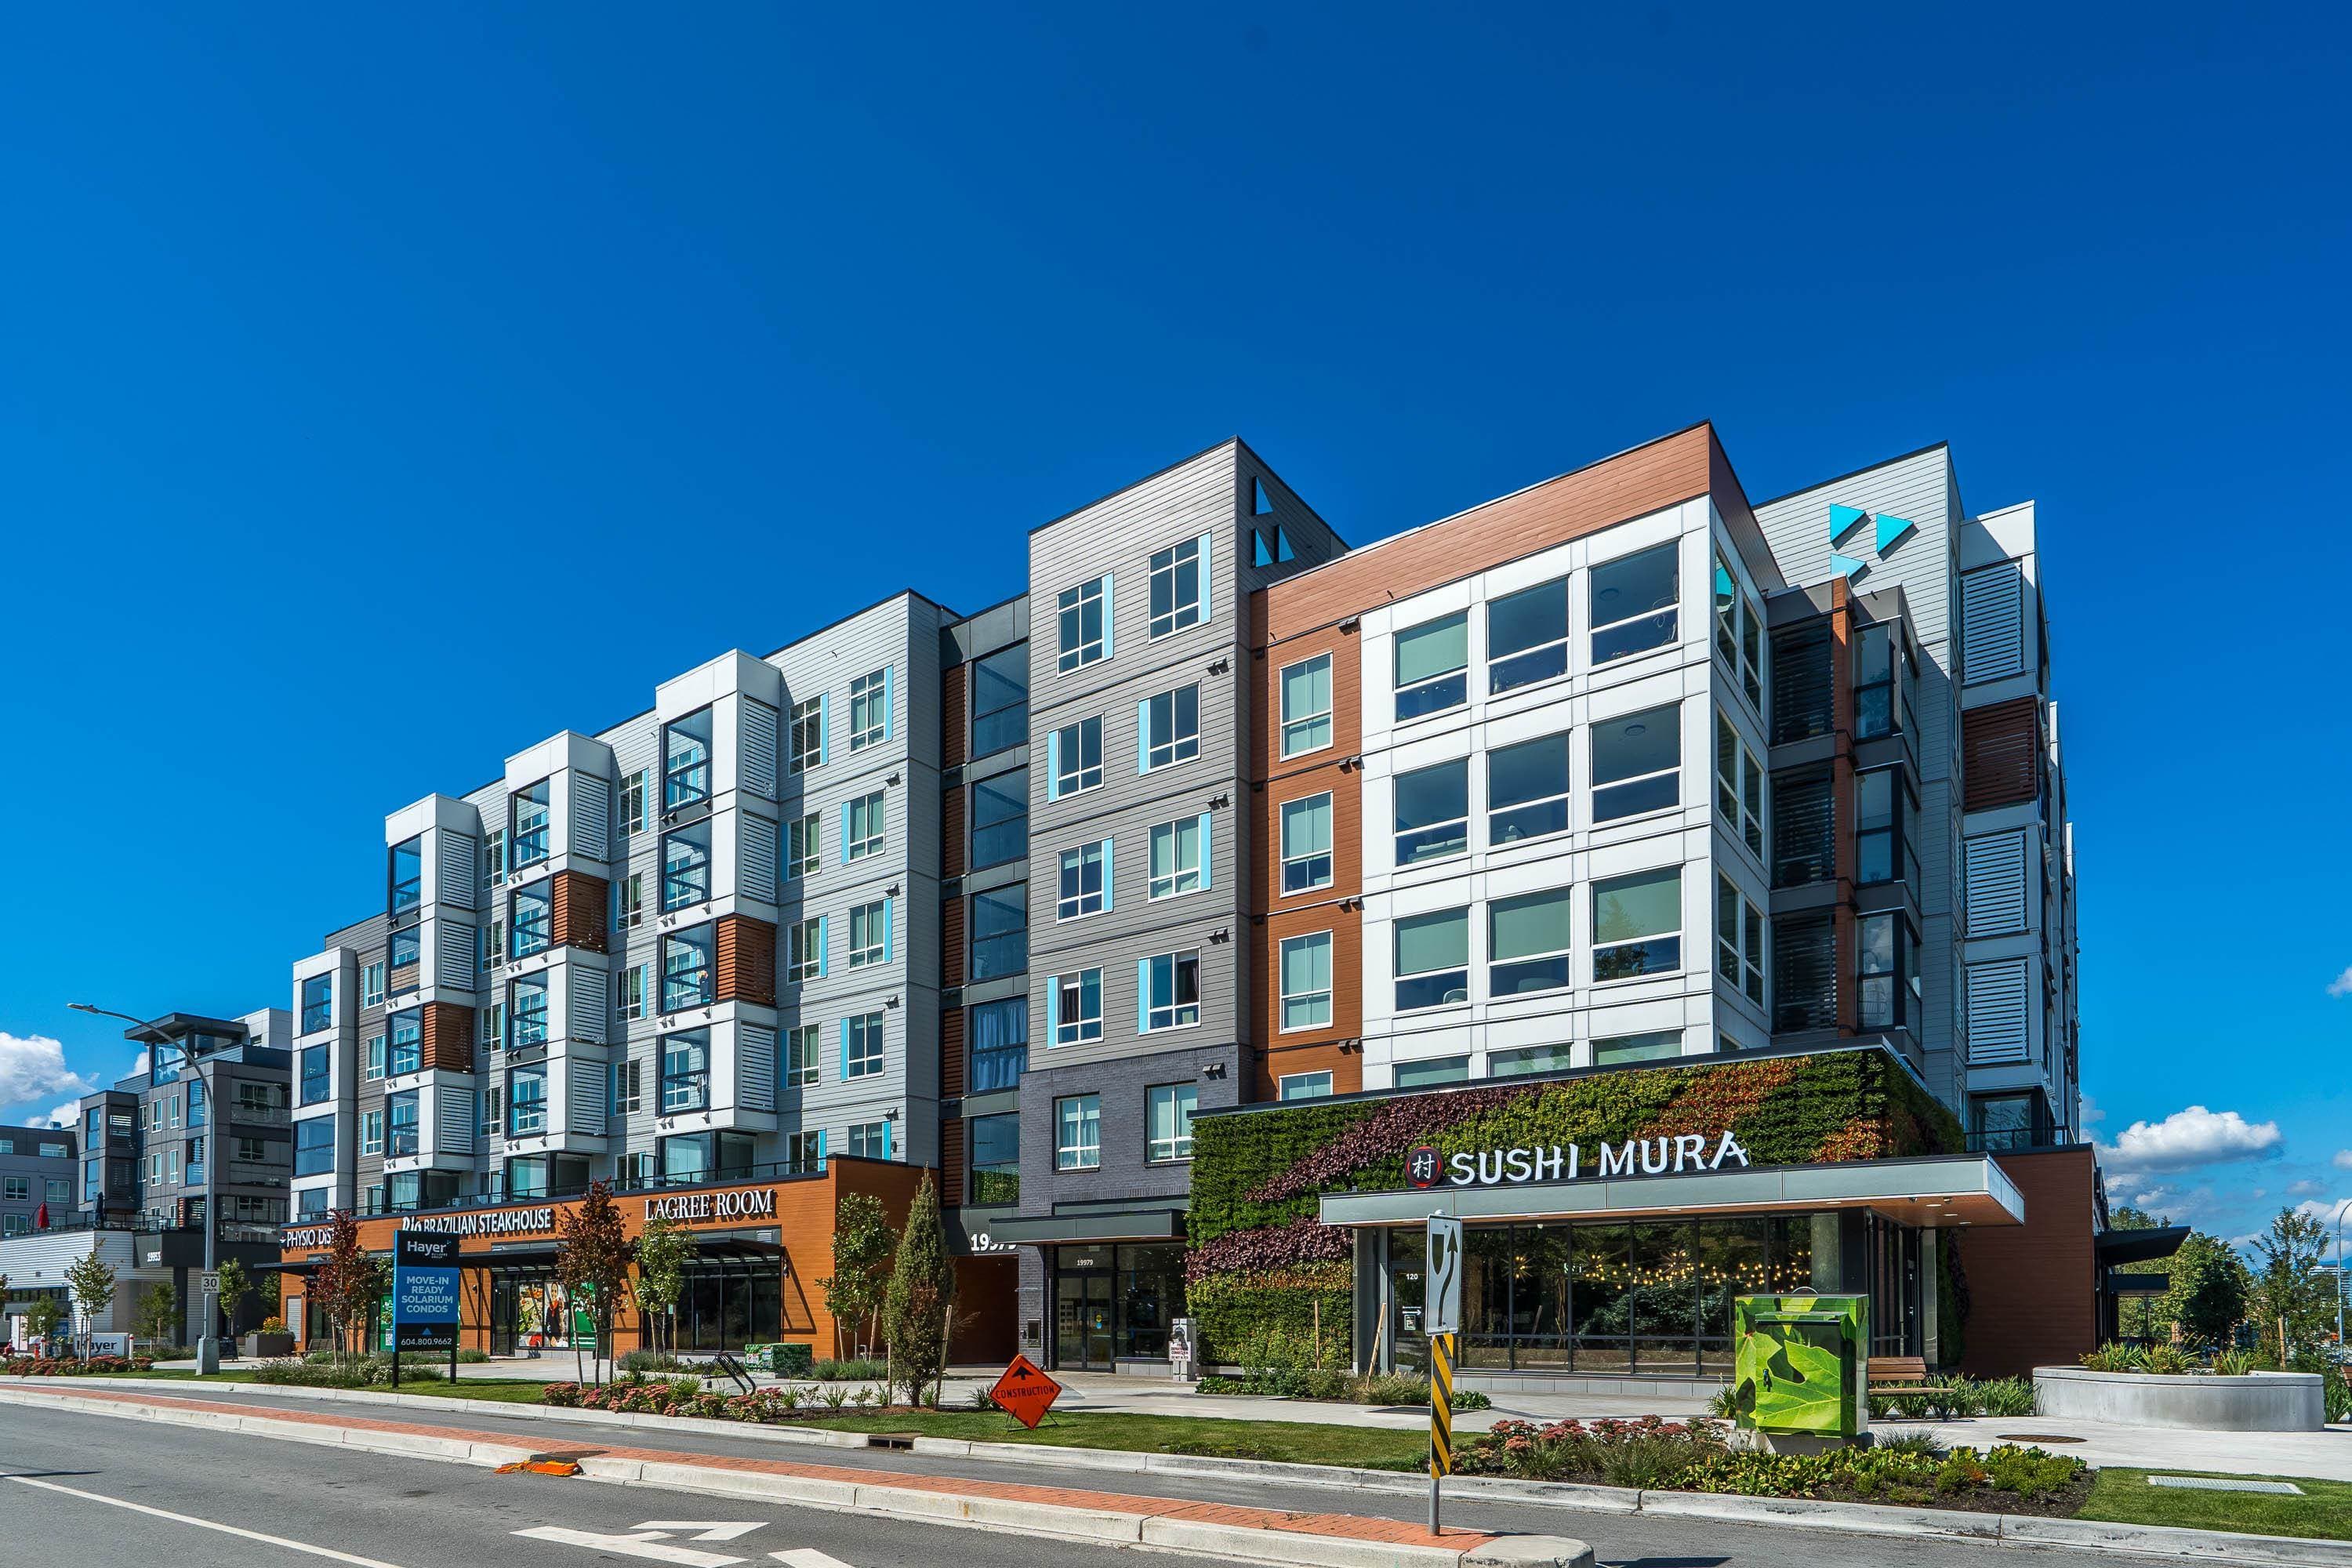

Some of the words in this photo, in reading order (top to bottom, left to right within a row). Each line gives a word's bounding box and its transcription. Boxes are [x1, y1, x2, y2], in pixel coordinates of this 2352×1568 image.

[1450, 1143, 1579, 1185] SUSHI
[1599, 1131, 1749, 1177] MURA
[1412, 1153, 1435, 1179] 村
[644, 1194, 710, 1221] LAGREE
[715, 1189, 773, 1216] ROOM
[424, 1214, 476, 1234] BRAZILIAN
[479, 1208, 551, 1233] STEAKHOUSE
[286, 1229, 315, 1247] PHYSIO
[408, 1240, 446, 1255] Hayer
[204, 1278, 217, 1287] 30
[406, 1276, 449, 1285] MOVE-IN
[401, 1295, 453, 1304] SOLARIUM
[406, 1305, 448, 1313] CONDOS
[401, 1338, 452, 1346] 604.800.9662
[995, 1385, 1054, 1399] CONSTRUCTION
